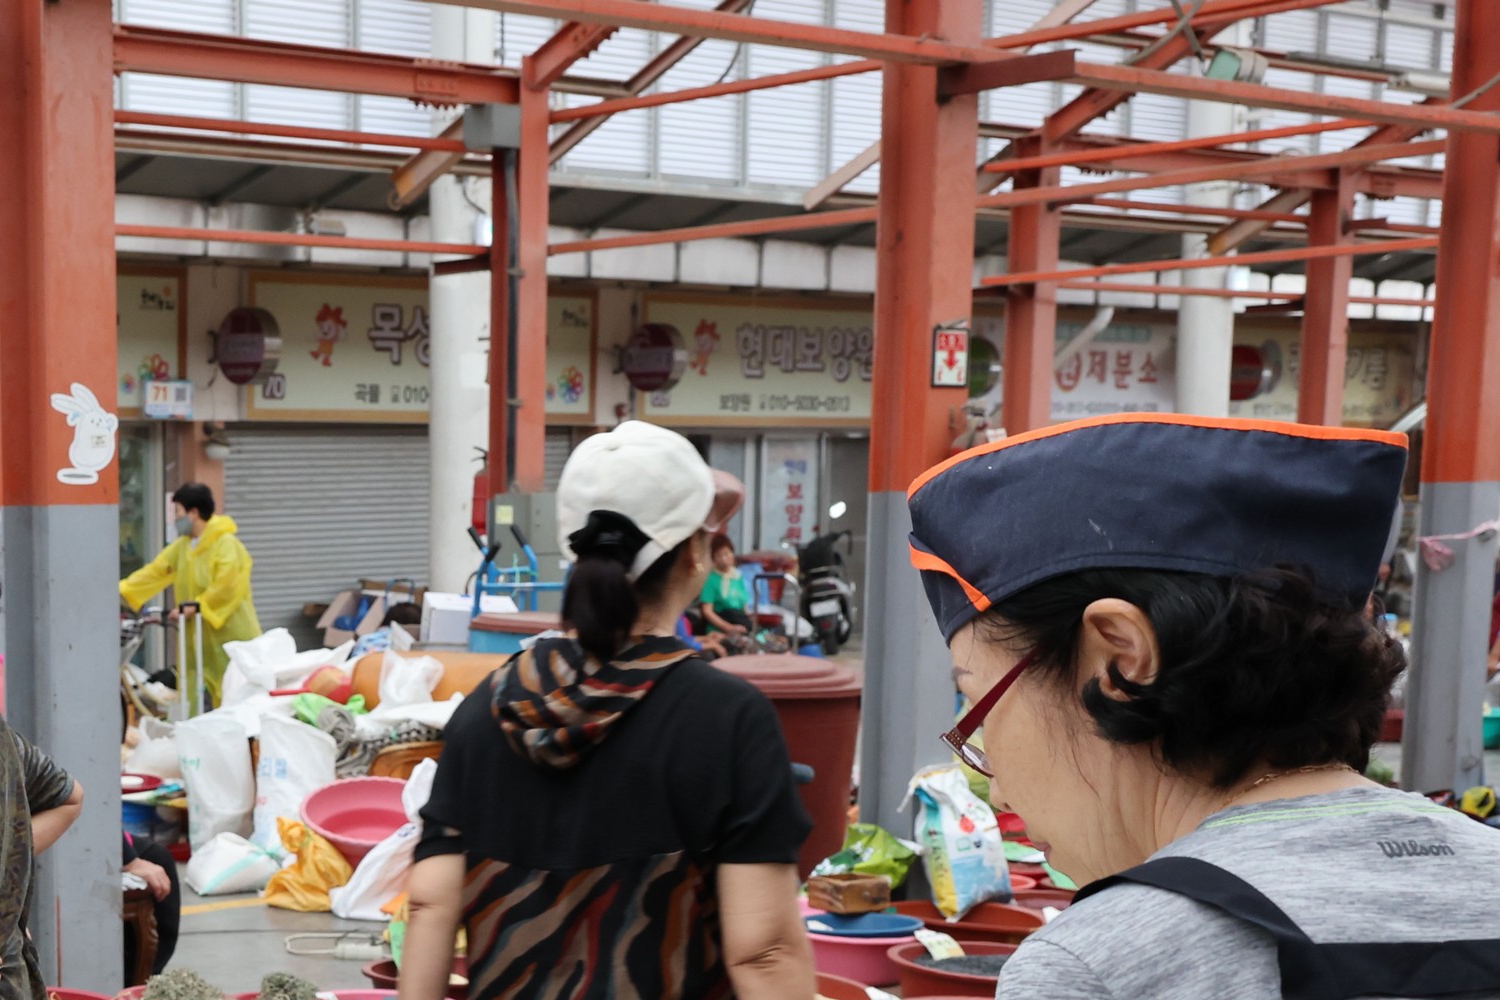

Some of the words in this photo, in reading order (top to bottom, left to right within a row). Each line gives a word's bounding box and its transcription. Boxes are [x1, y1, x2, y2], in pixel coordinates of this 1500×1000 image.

[153, 386, 168, 402] 71
[264, 376, 285, 399] 70
[1377, 840, 1455, 858] Wilson
